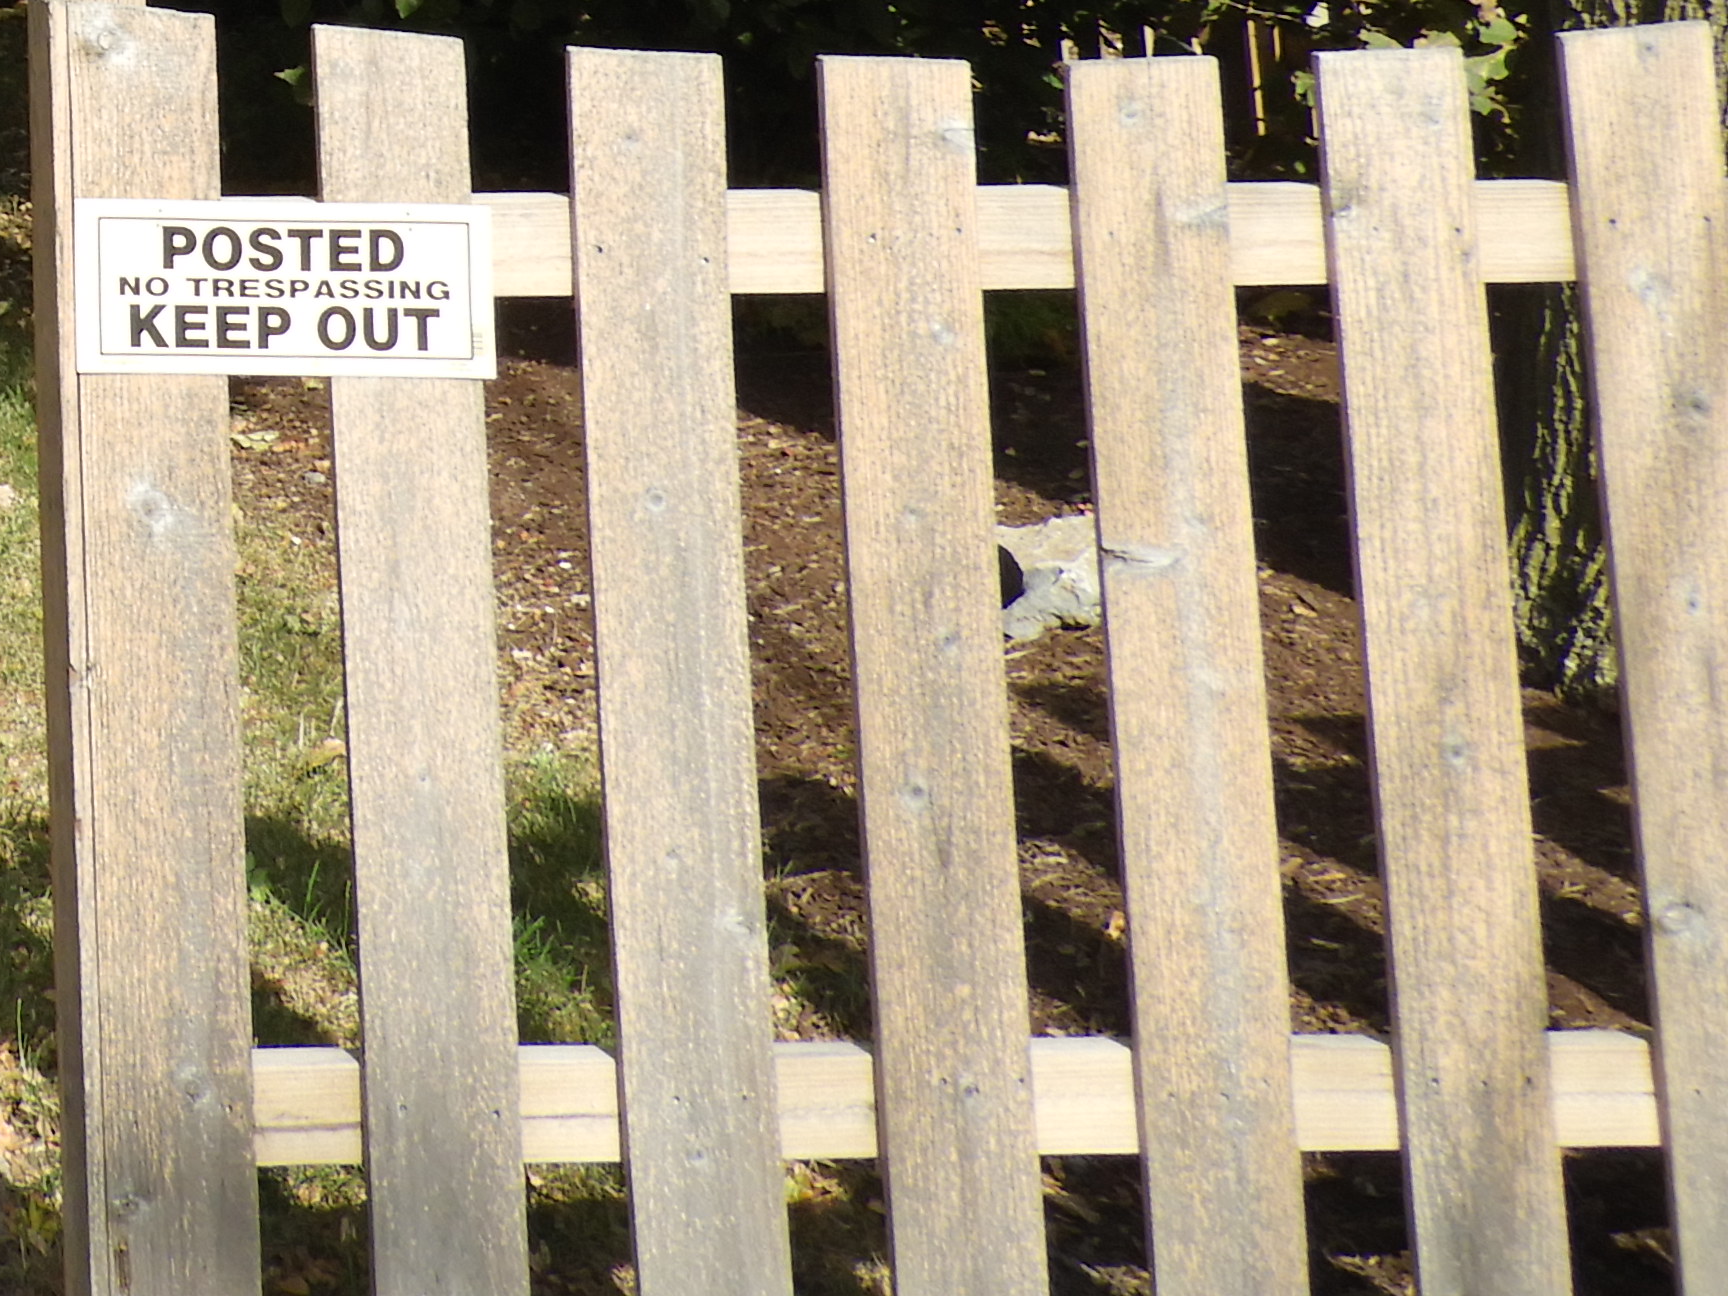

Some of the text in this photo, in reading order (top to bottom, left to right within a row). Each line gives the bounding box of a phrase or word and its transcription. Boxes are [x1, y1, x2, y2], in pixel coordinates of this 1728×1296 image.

[162, 225, 405, 272] POSTED
[119, 276, 450, 301] NO TRESPASSING
[129, 304, 292, 350] KEEP
[317, 305, 440, 352] OUT
